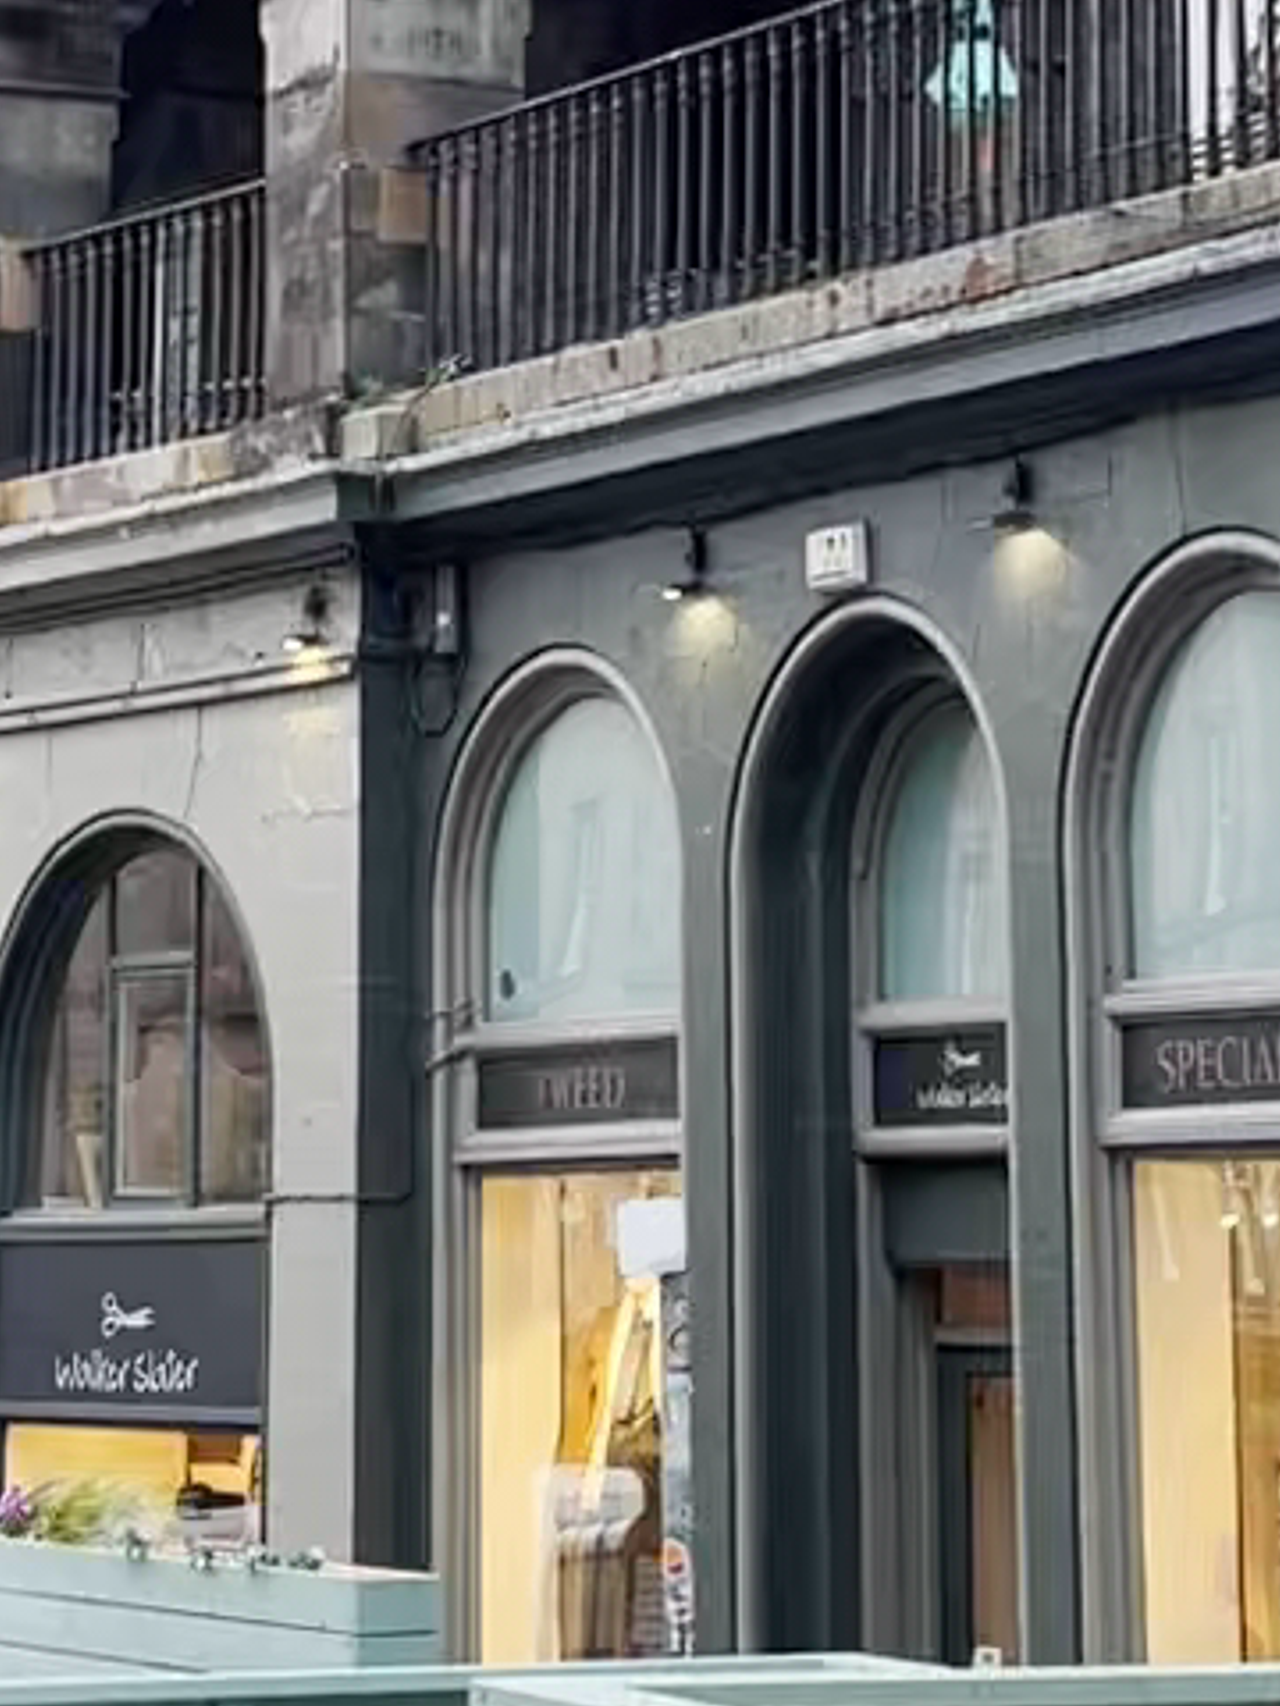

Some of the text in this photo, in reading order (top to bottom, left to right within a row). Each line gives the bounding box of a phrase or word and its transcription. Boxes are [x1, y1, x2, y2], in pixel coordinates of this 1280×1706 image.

[538, 1065, 626, 1109] TWEED
[54, 1347, 199, 1393] Walker Slater
